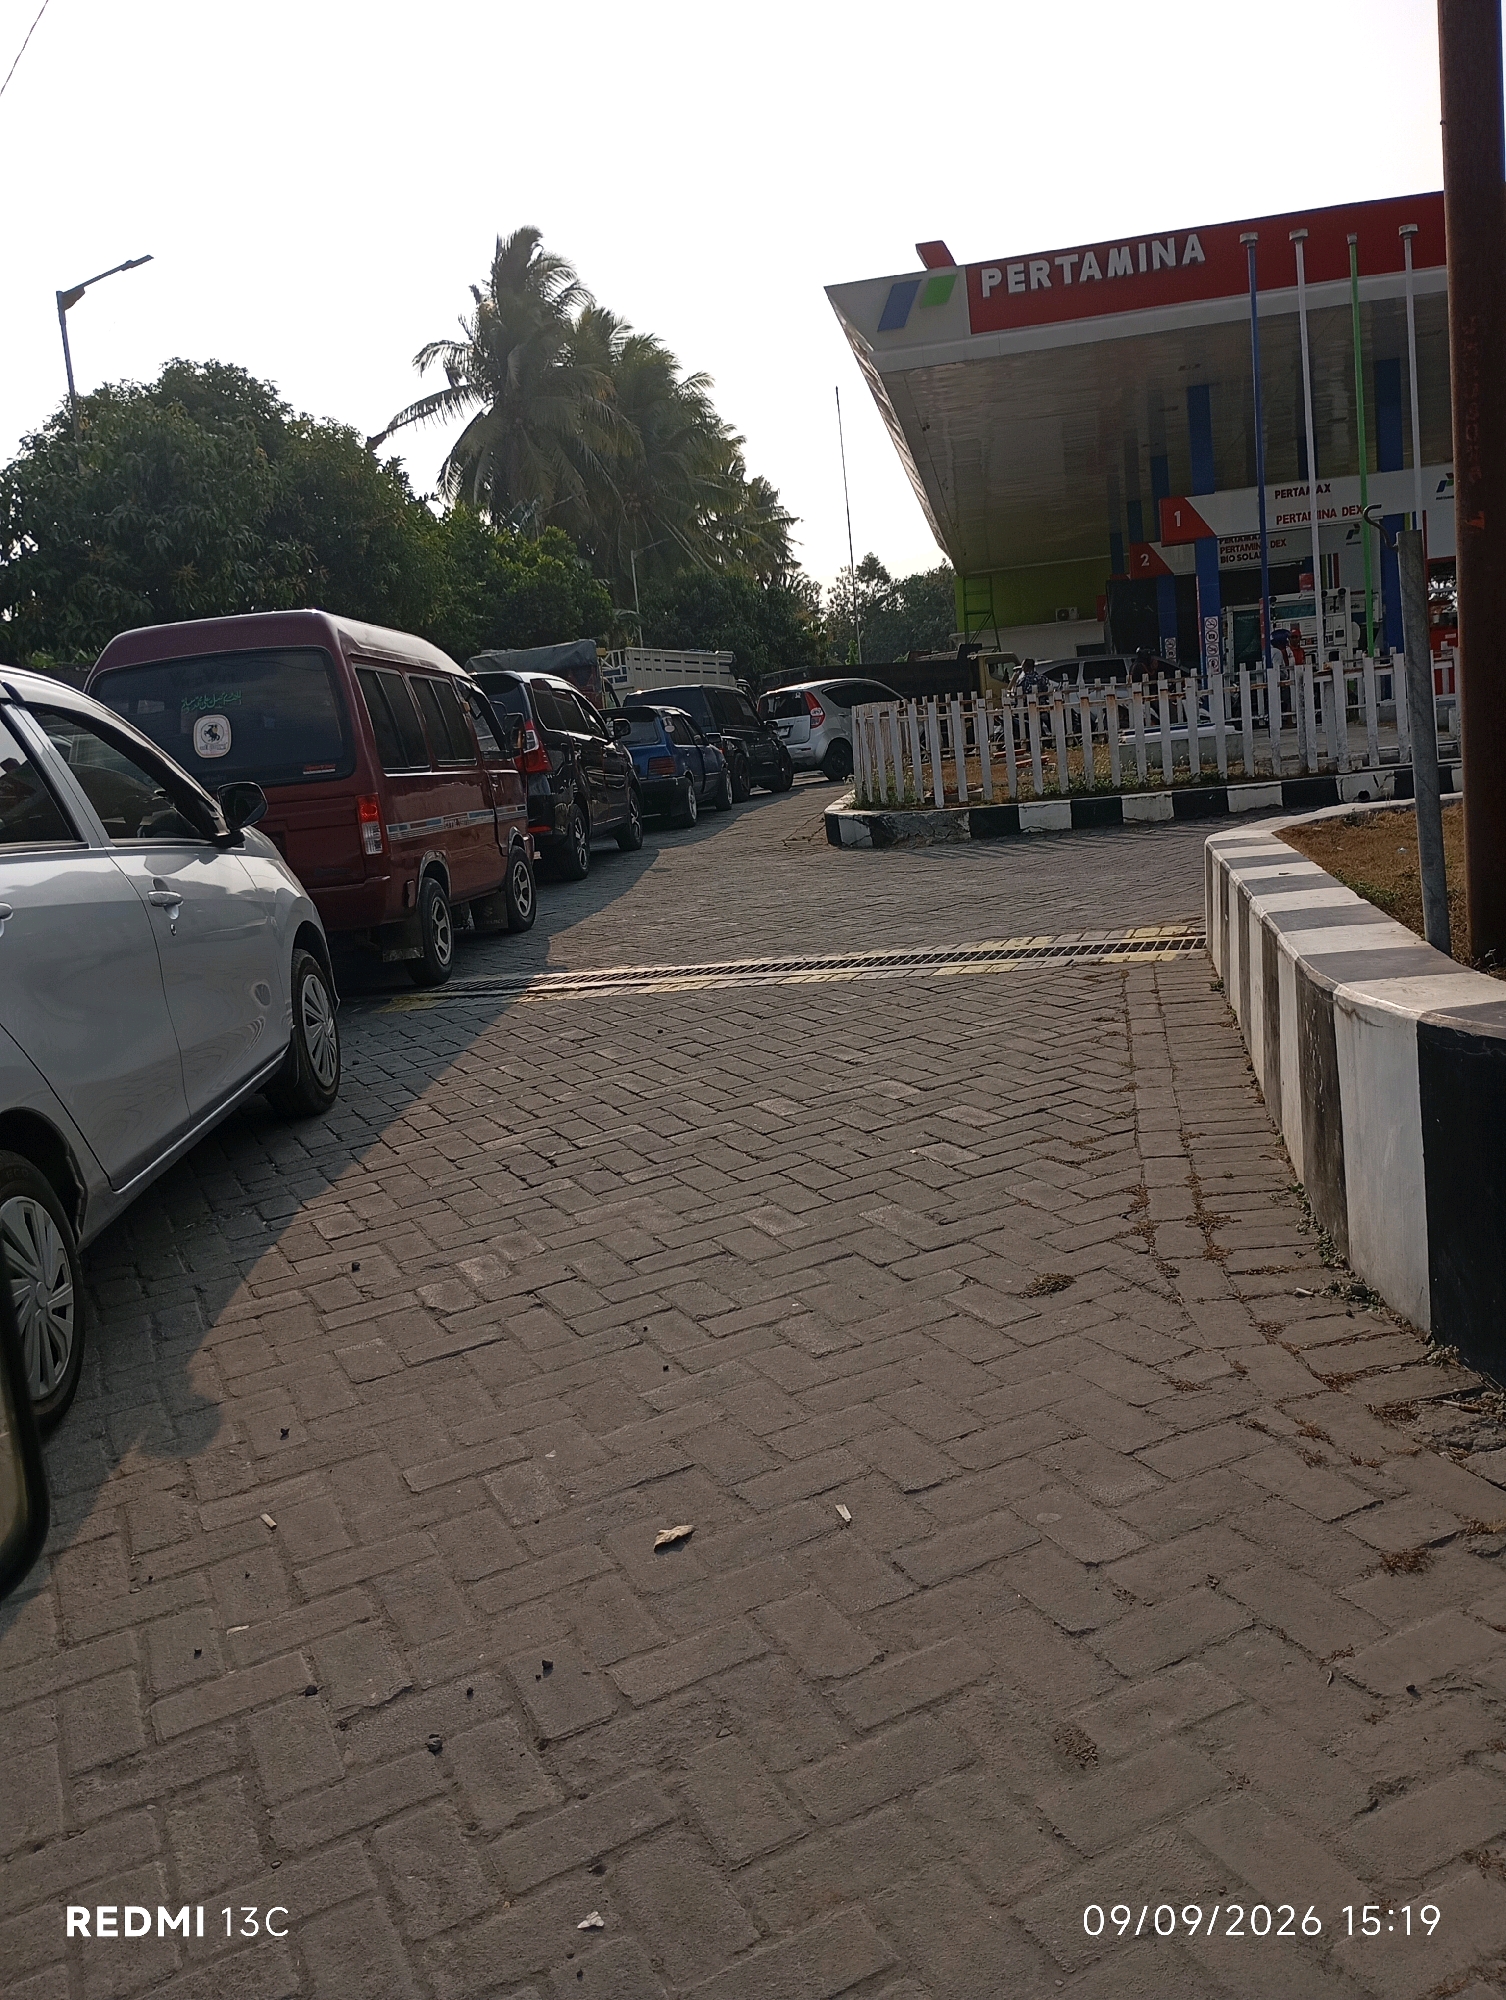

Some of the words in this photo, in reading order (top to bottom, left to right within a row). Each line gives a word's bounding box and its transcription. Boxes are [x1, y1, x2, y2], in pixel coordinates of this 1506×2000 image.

[981, 233, 1206, 299] PERTAMINA
[1173, 510, 1182, 527] 1
[1219, 542, 1261, 554] PERTAMIN
[1270, 538, 1287, 549] DEX
[1140, 553, 1150, 567] 2
[1220, 555, 1235, 564] BIO
[1236, 551, 1262, 562] SOLA
